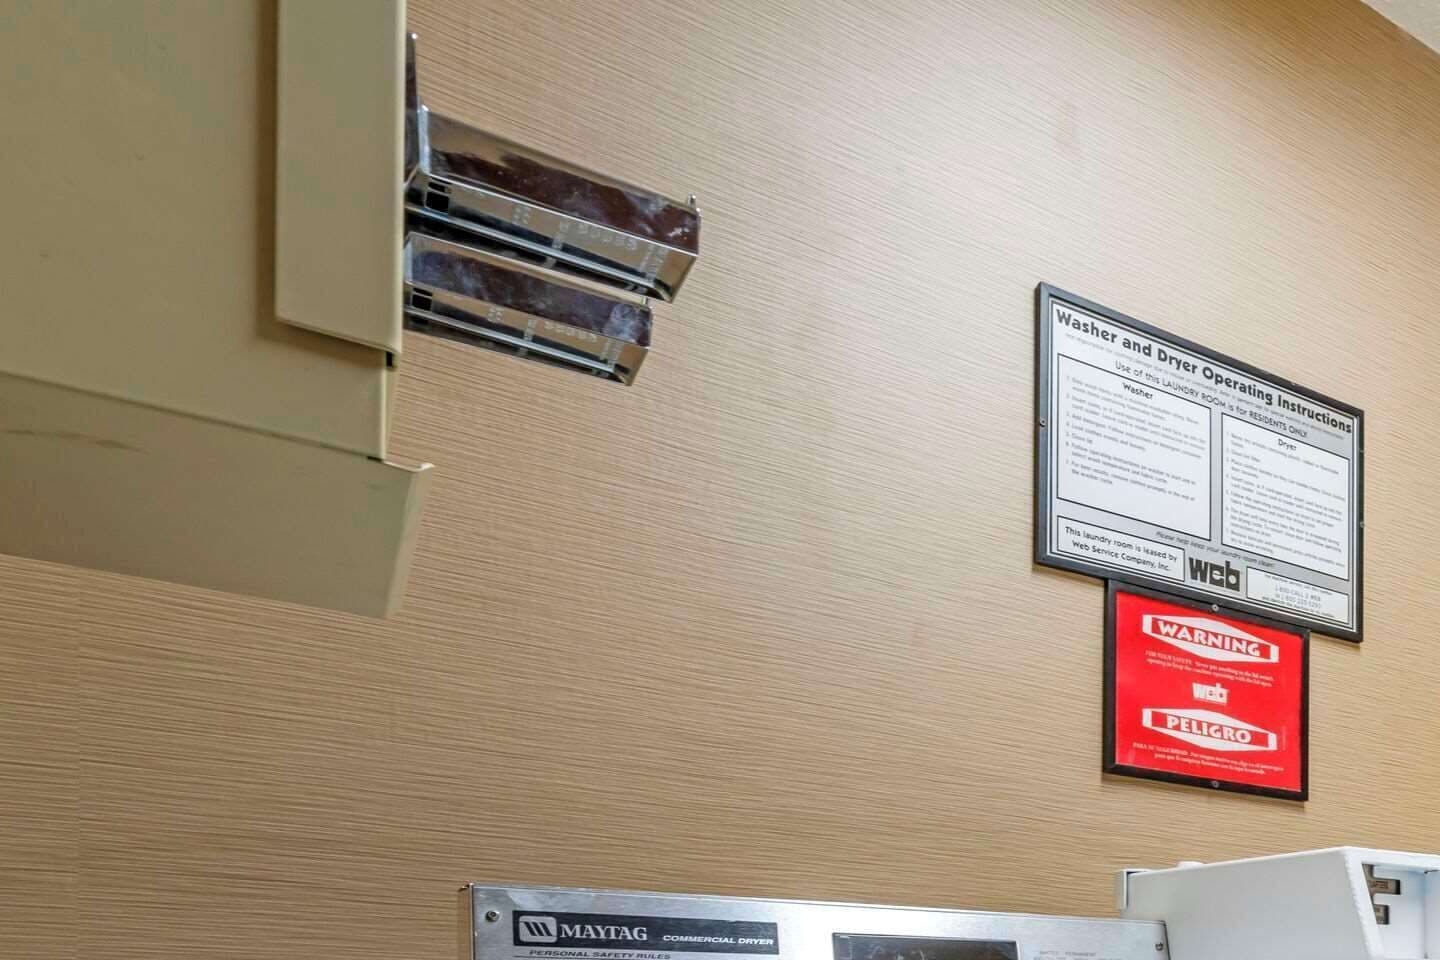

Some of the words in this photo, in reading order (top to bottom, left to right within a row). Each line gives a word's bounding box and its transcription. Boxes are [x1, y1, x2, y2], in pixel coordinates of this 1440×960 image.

[1056, 309, 1118, 343] Washer
[1122, 337, 1152, 357] and
[1158, 348, 1198, 374] Dryer
[1202, 366, 1273, 406] Operating
[1278, 395, 1352, 433] Instructions
[1115, 360, 1131, 374] Use
[1134, 369, 1143, 377] of
[1145, 372, 1160, 384] this
[1162, 379, 1199, 398] LAUNDRY
[1201, 393, 1225, 408] ROOM
[1228, 402, 1234, 411] is
[1236, 404, 1247, 416] for
[1249, 411, 1287, 431] RESIDENTS
[1288, 425, 1308, 438] ONLY
[1122, 382, 1153, 400] Washer
[1278, 438, 1297, 451] Dryer
[1065, 526, 1081, 537] This
[1083, 531, 1112, 545] laundry
[1113, 540, 1133, 551] room
[1135, 544, 1141, 553] is
[1143, 546, 1167, 559] leased
[1168, 554, 1177, 563] by
[1072, 540, 1090, 551] Web
[1092, 545, 1119, 560] Service
[1121, 552, 1156, 569] Company,
[1158, 561, 1171, 572] Inc.
[1188, 556, 1241, 592] web
[1157, 620, 1260, 657] WARNING
[1192, 682, 1229, 705] web
[1166, 714, 1252, 744] PELIGRO
[560, 923, 648, 941] MAYTAG
[663, 934, 736, 945] COMMERCIAL
[738, 937, 774, 946] DRYER
[529, 949, 590, 958] PERSONAL
[592, 951, 634, 959] SAFETY
